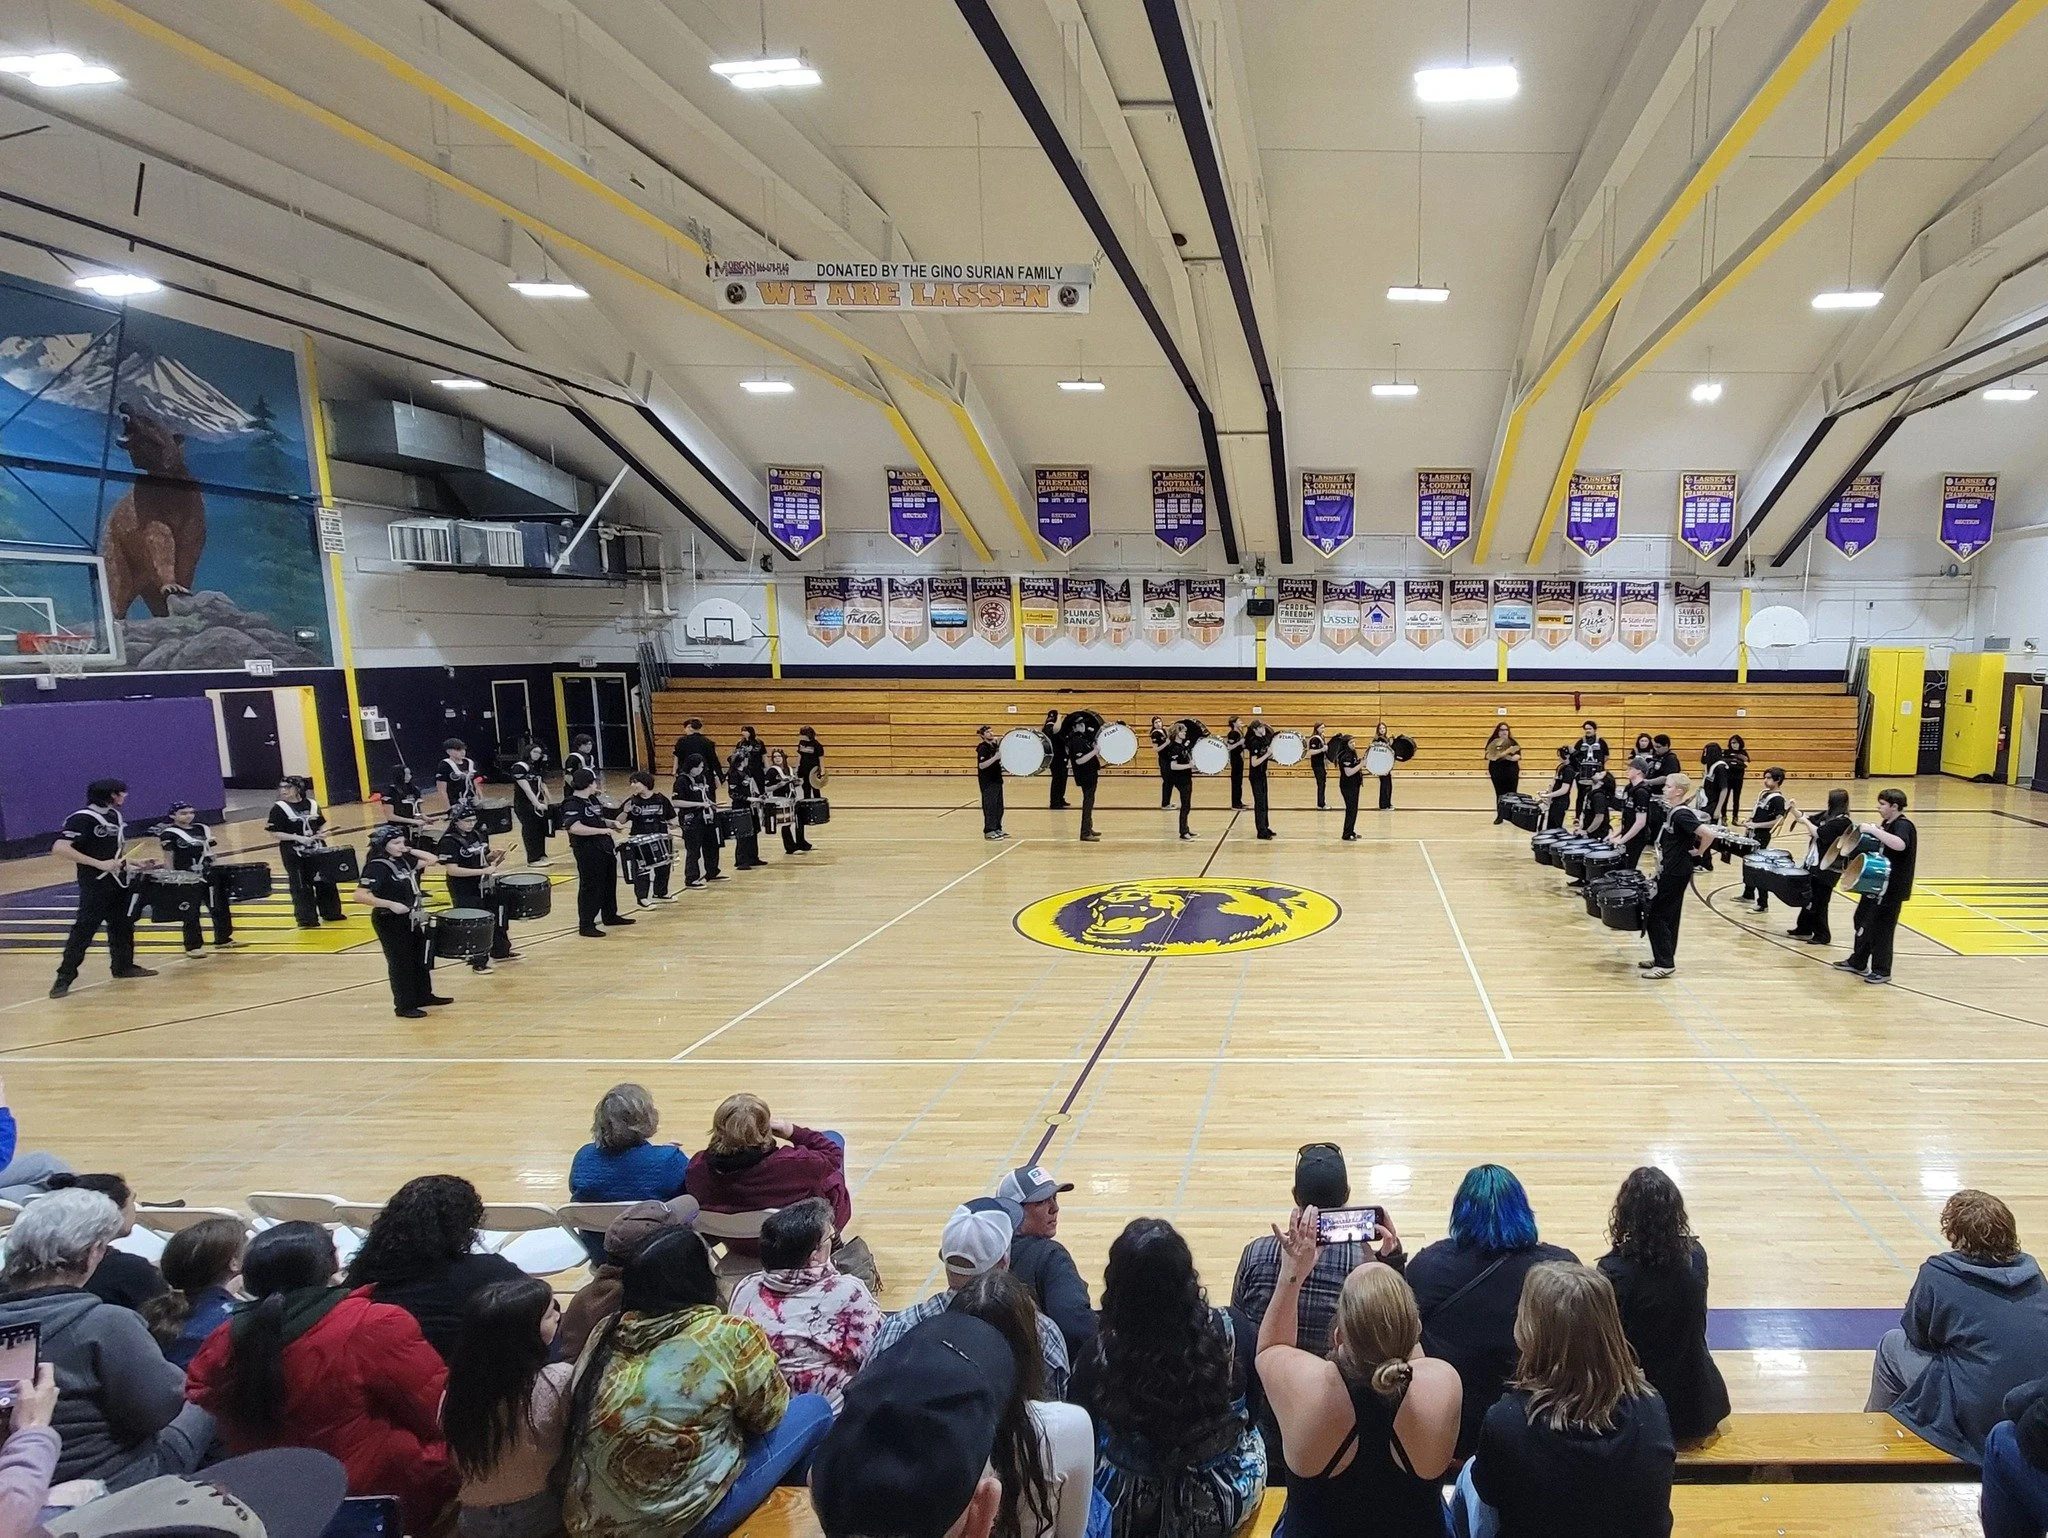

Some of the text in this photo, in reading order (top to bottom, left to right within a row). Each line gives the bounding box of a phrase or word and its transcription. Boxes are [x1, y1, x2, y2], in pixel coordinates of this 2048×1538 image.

[817, 264, 1063, 280] DONATED BY THE GINO SURIAN FAMILY
[756, 281, 1050, 308] WE ARE LASSEN
[779, 470, 812, 479] LASSEN
[1162, 472, 1194, 480] LASSEN
[1429, 474, 1461, 482] LASSEN
[1694, 476, 1726, 484] LASSEN
[770, 484, 820, 495] CHAMPIONSHIPS
[1038, 486, 1088, 494] CHAMPIONSHIPS
[1154, 486, 1204, 495] CHAMPIONSHIPS
[1304, 489, 1353, 497] CHAMPIONSHIPS
[1420, 489, 1469, 497] CHAMPIONSHIPS
[1684, 491, 1733, 499] CHAMPIONSHIPS
[1945, 492, 1994, 501] CHAMPIONSHIPS
[1280, 610, 1313, 618] FREEDOM
[1064, 617, 1088, 625] BANK
[1324, 616, 1359, 624] LASSEN
[1678, 615, 1705, 625] FEED
